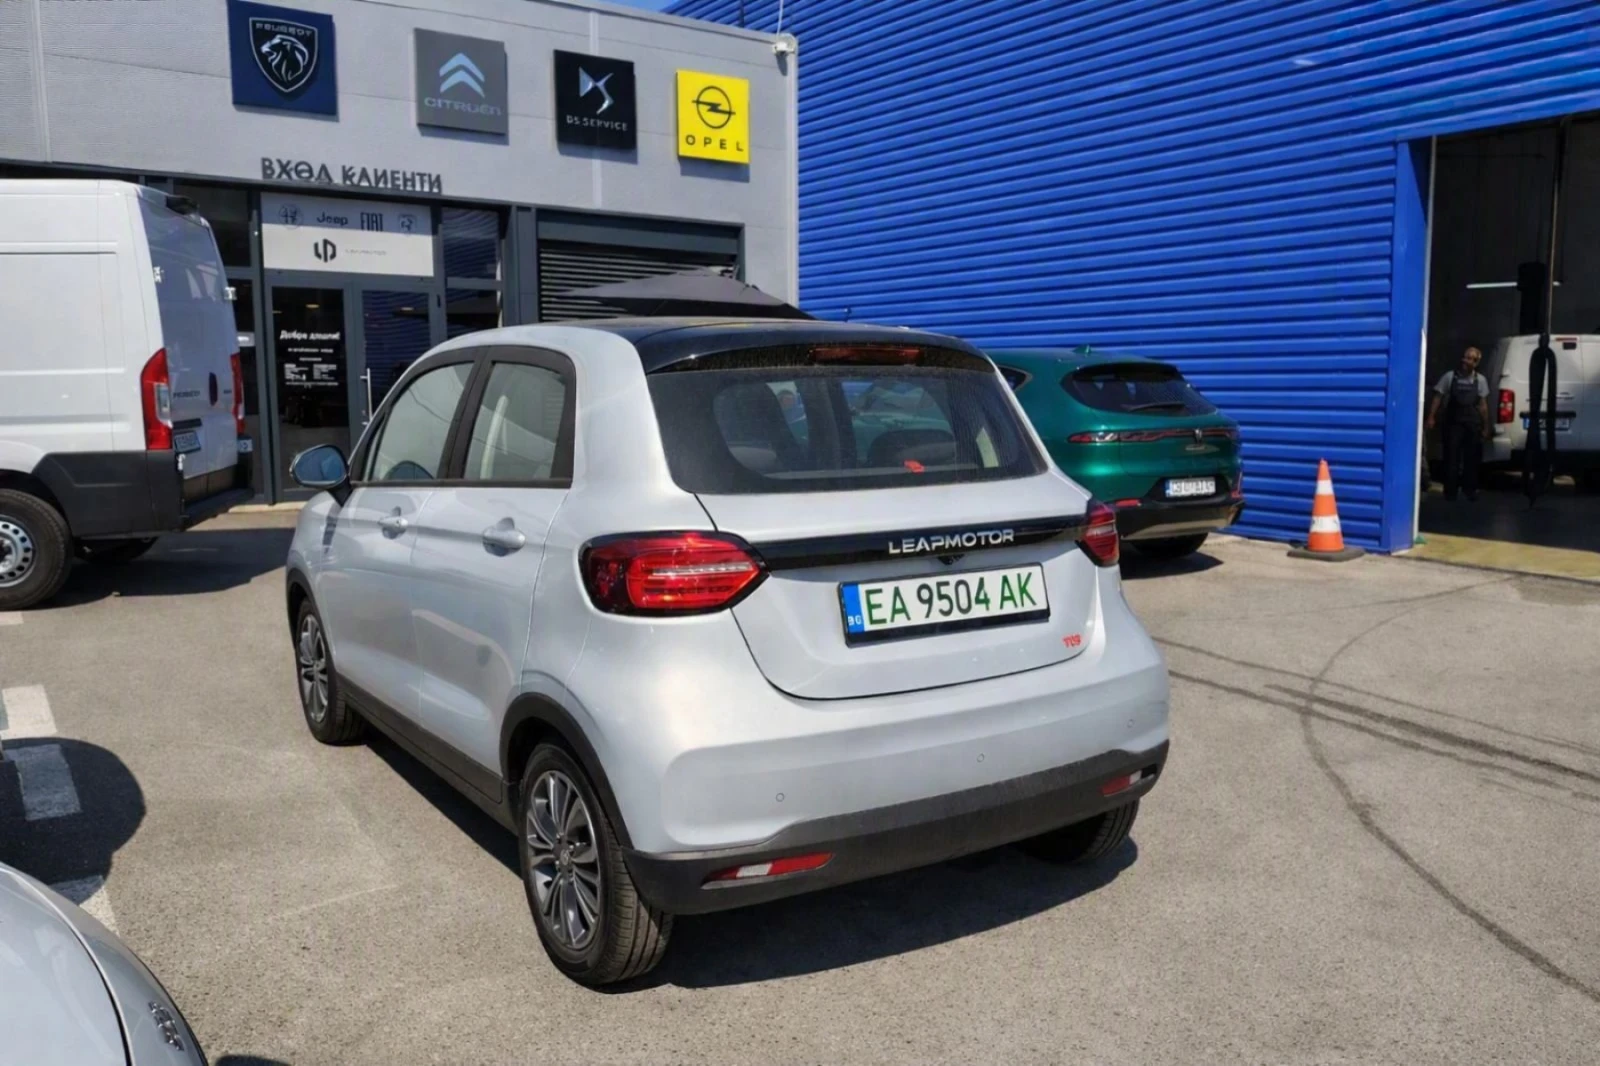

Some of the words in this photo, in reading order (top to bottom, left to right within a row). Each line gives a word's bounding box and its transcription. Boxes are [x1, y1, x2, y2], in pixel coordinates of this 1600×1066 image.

[582, 117, 628, 131] SERVICE
[685, 134, 744, 152] OPEL
[316, 211, 349, 227] Jeep
[360, 212, 384, 231] FIAT
[888, 529, 1015, 554] LEAPMOTOR
[865, 586, 911, 625] EA
[917, 576, 991, 619] 9504
[999, 571, 1037, 611] AK
